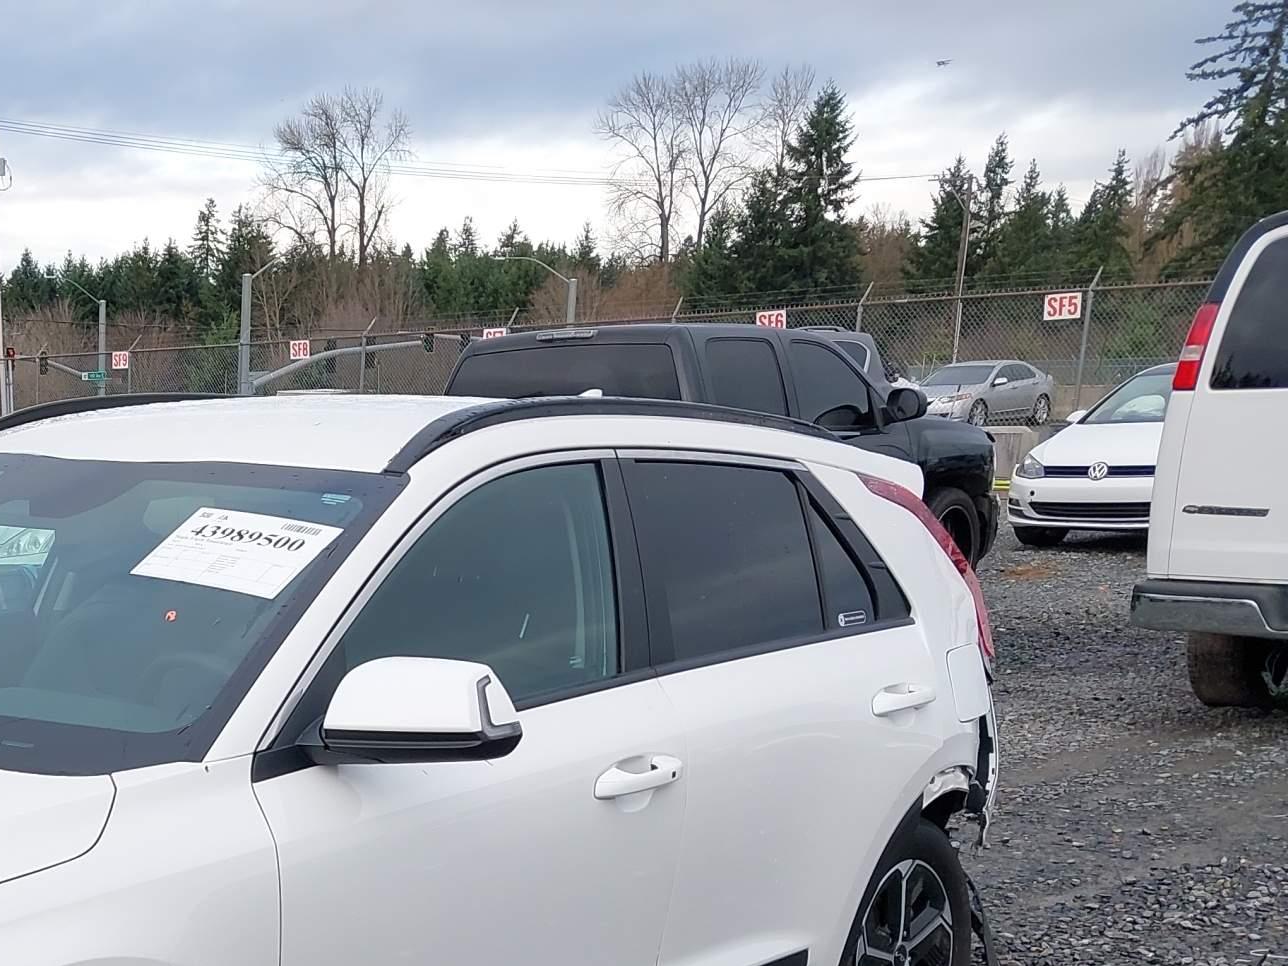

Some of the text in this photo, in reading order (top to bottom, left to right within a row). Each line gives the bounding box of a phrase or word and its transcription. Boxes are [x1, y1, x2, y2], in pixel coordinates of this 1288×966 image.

[1047, 295, 1079, 317] SF5
[759, 313, 784, 328] SF6
[292, 342, 309, 357] SF8
[113, 352, 128, 367] SF9
[191, 523, 306, 552] 43989500
